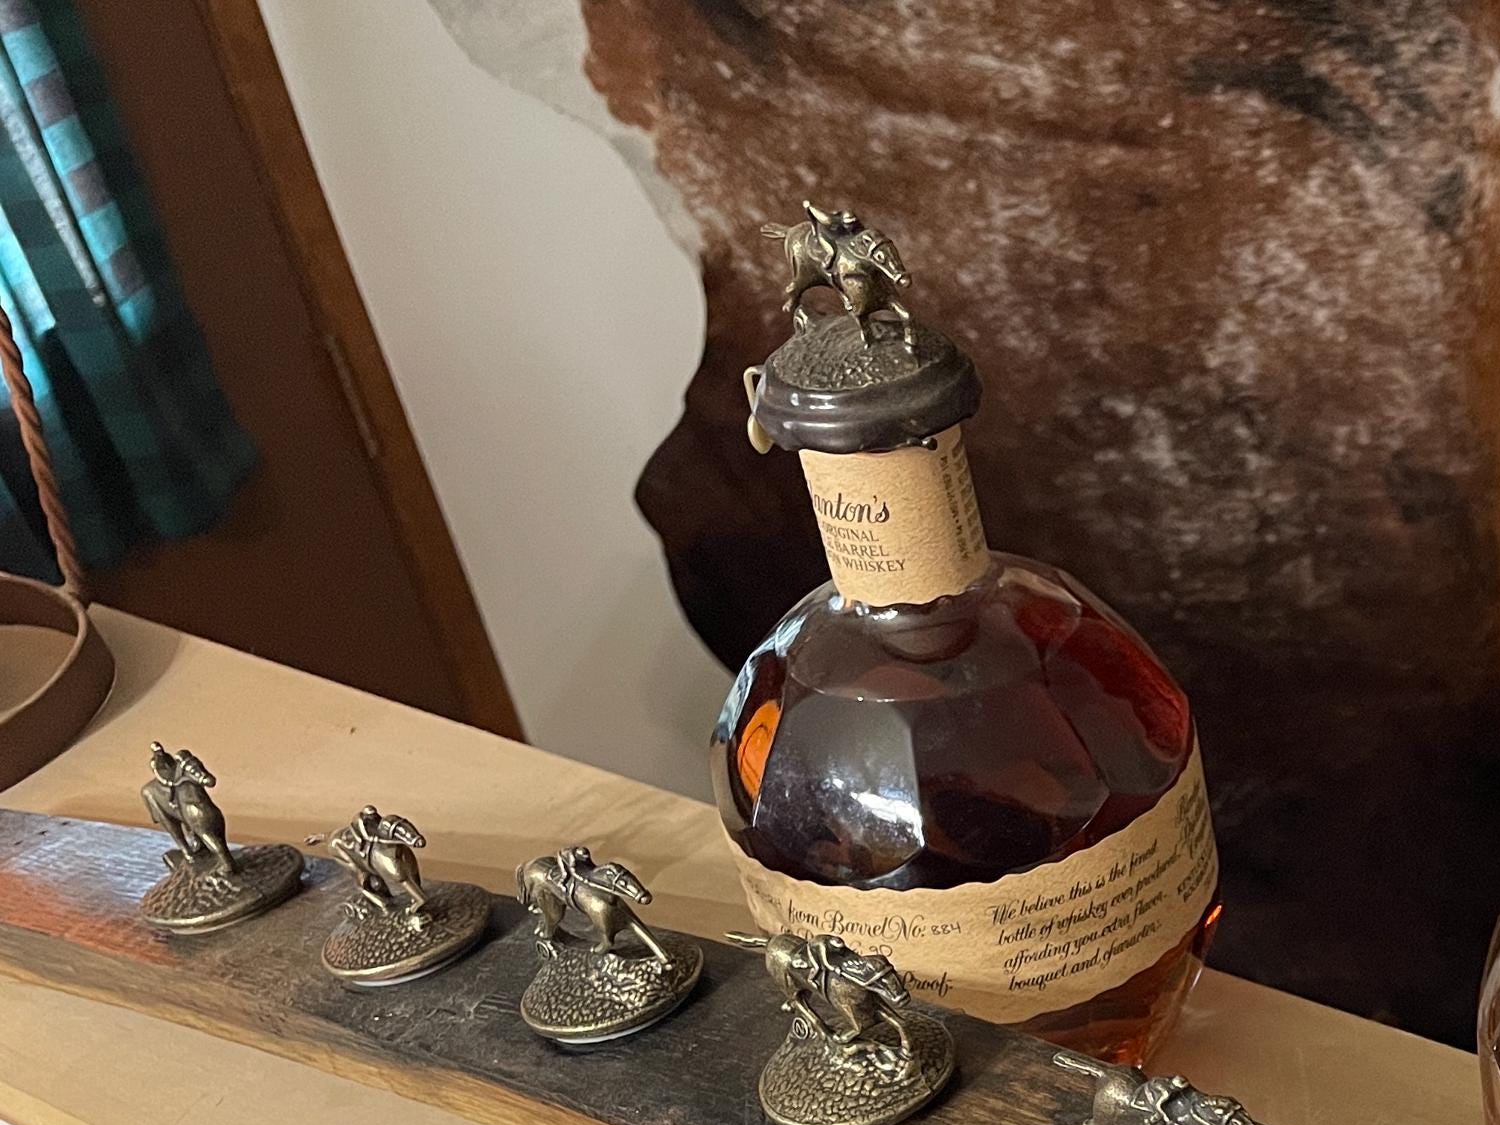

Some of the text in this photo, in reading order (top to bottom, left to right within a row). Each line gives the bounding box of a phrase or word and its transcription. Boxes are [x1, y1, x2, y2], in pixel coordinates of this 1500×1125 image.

[812, 492, 890, 524] anton's
[824, 523, 879, 542] RIGINAL
[834, 540, 890, 560] BARREL
[841, 556, 907, 574] WHISKEY
[984, 899, 1020, 926] We
[1019, 894, 1065, 917] believe
[1068, 880, 1092, 901] this
[1095, 874, 1106, 890] is
[1108, 862, 1127, 882] the
[788, 898, 819, 925] from
[821, 909, 889, 938] Barrel
[930, 921, 962, 936] 884
[998, 922, 1037, 946] bottle
[1039, 914, 1059, 940] of
[1056, 898, 1109, 936] whiskey
[1003, 941, 1072, 977] affording
[1070, 930, 1099, 956] you
[1100, 914, 1131, 939] extra
[1007, 961, 1069, 992] bouquet
[1069, 946, 1100, 975] and
